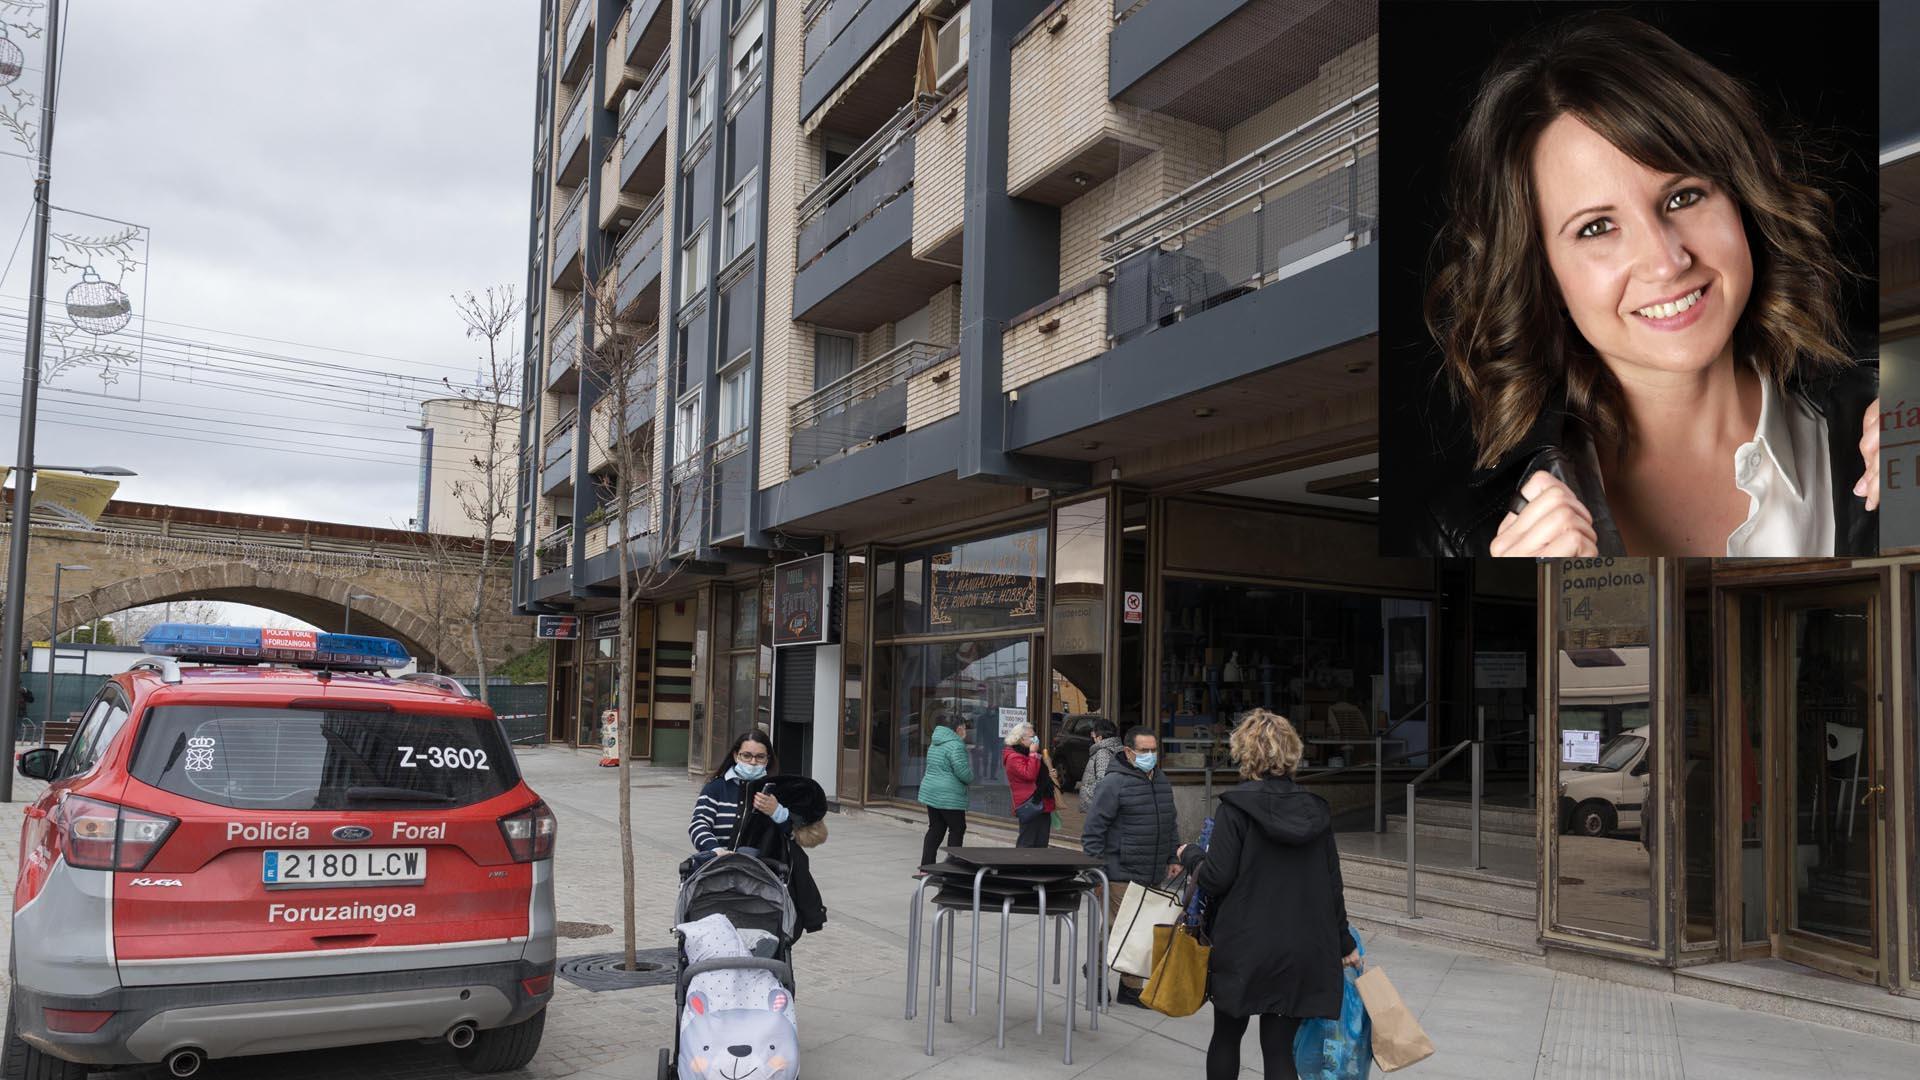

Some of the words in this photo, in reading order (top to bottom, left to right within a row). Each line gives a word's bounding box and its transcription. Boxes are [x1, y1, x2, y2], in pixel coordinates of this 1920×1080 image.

[1563, 557, 1614, 574] paseo
[1563, 572, 1645, 592] pamplona
[998, 585, 1028, 604] HOBBY
[1562, 597, 1592, 621] 14
[268, 638, 311, 648] FORUZAINGOA
[398, 746, 490, 771] Z-3602
[227, 822, 309, 841] Policía
[392, 822, 446, 840] Foral
[341, 829, 364, 840] Ford
[267, 870, 275, 878] E
[284, 853, 357, 878] 2180
[368, 852, 419, 877] LCW
[129, 878, 183, 887] KUGA
[268, 901, 416, 923] Foruzaingoa
